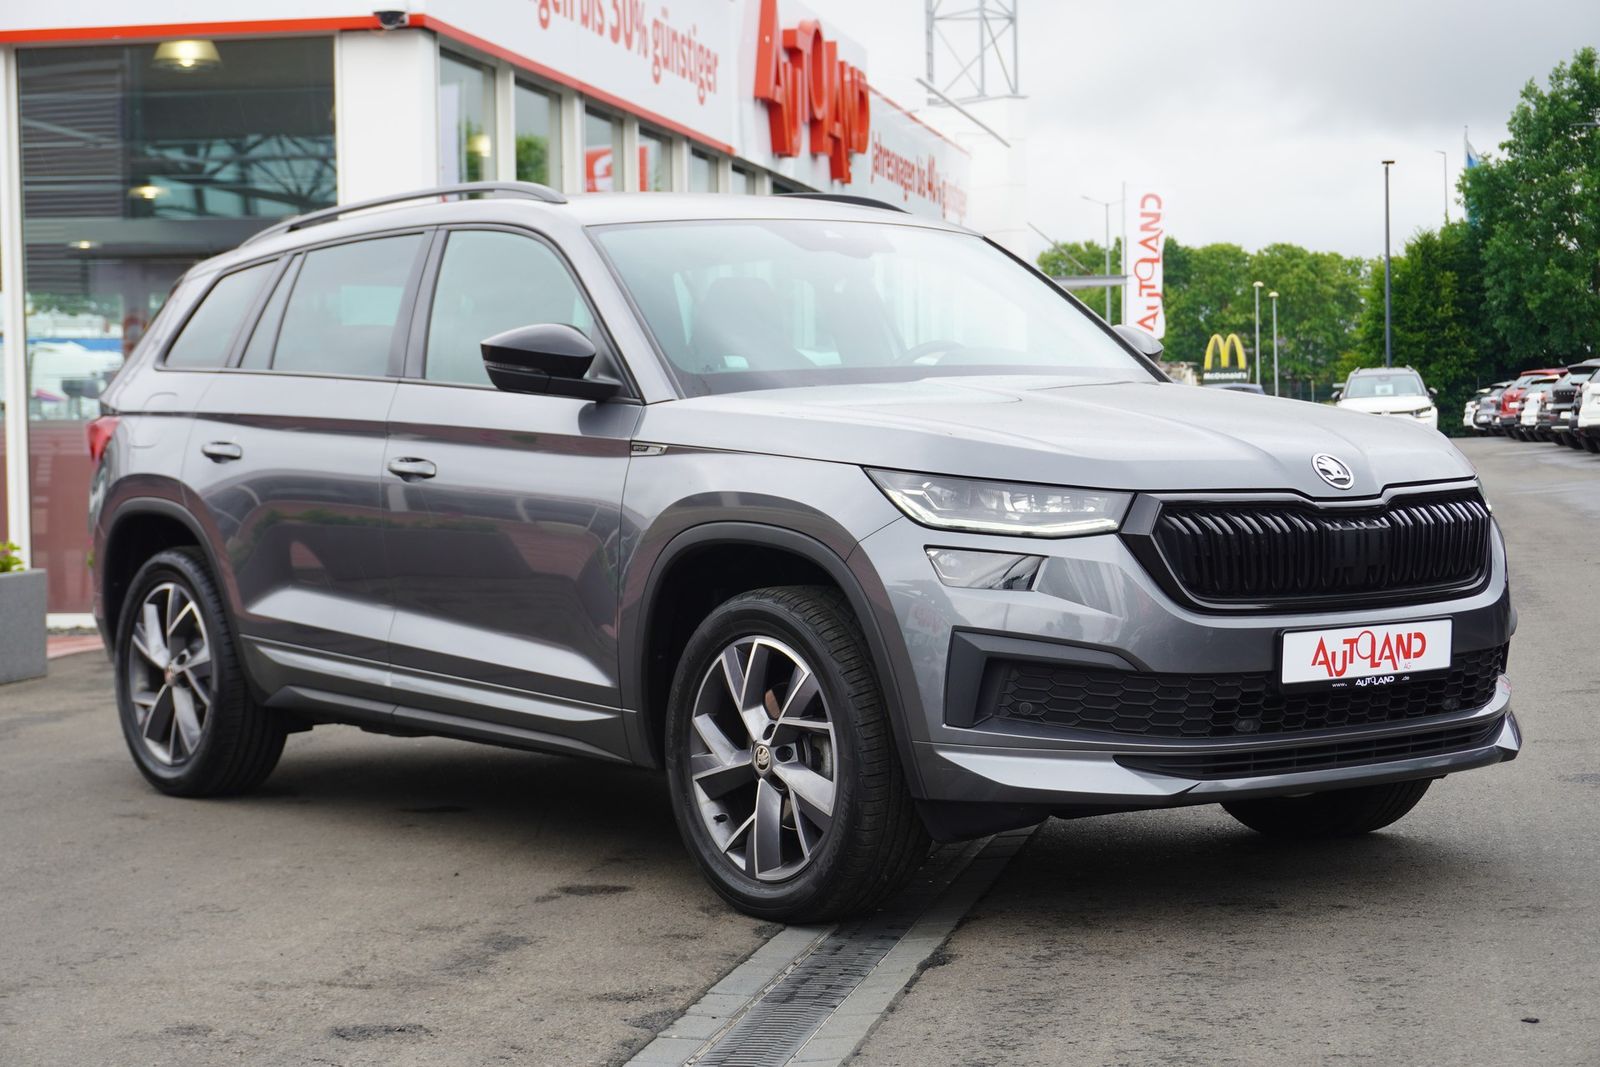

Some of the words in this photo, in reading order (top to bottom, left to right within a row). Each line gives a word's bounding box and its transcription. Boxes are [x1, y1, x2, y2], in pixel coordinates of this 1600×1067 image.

[652, 6, 718, 105] günstiger
[1311, 630, 1427, 677] AUTOLAND
[1355, 675, 1395, 687] AUTOLAND
